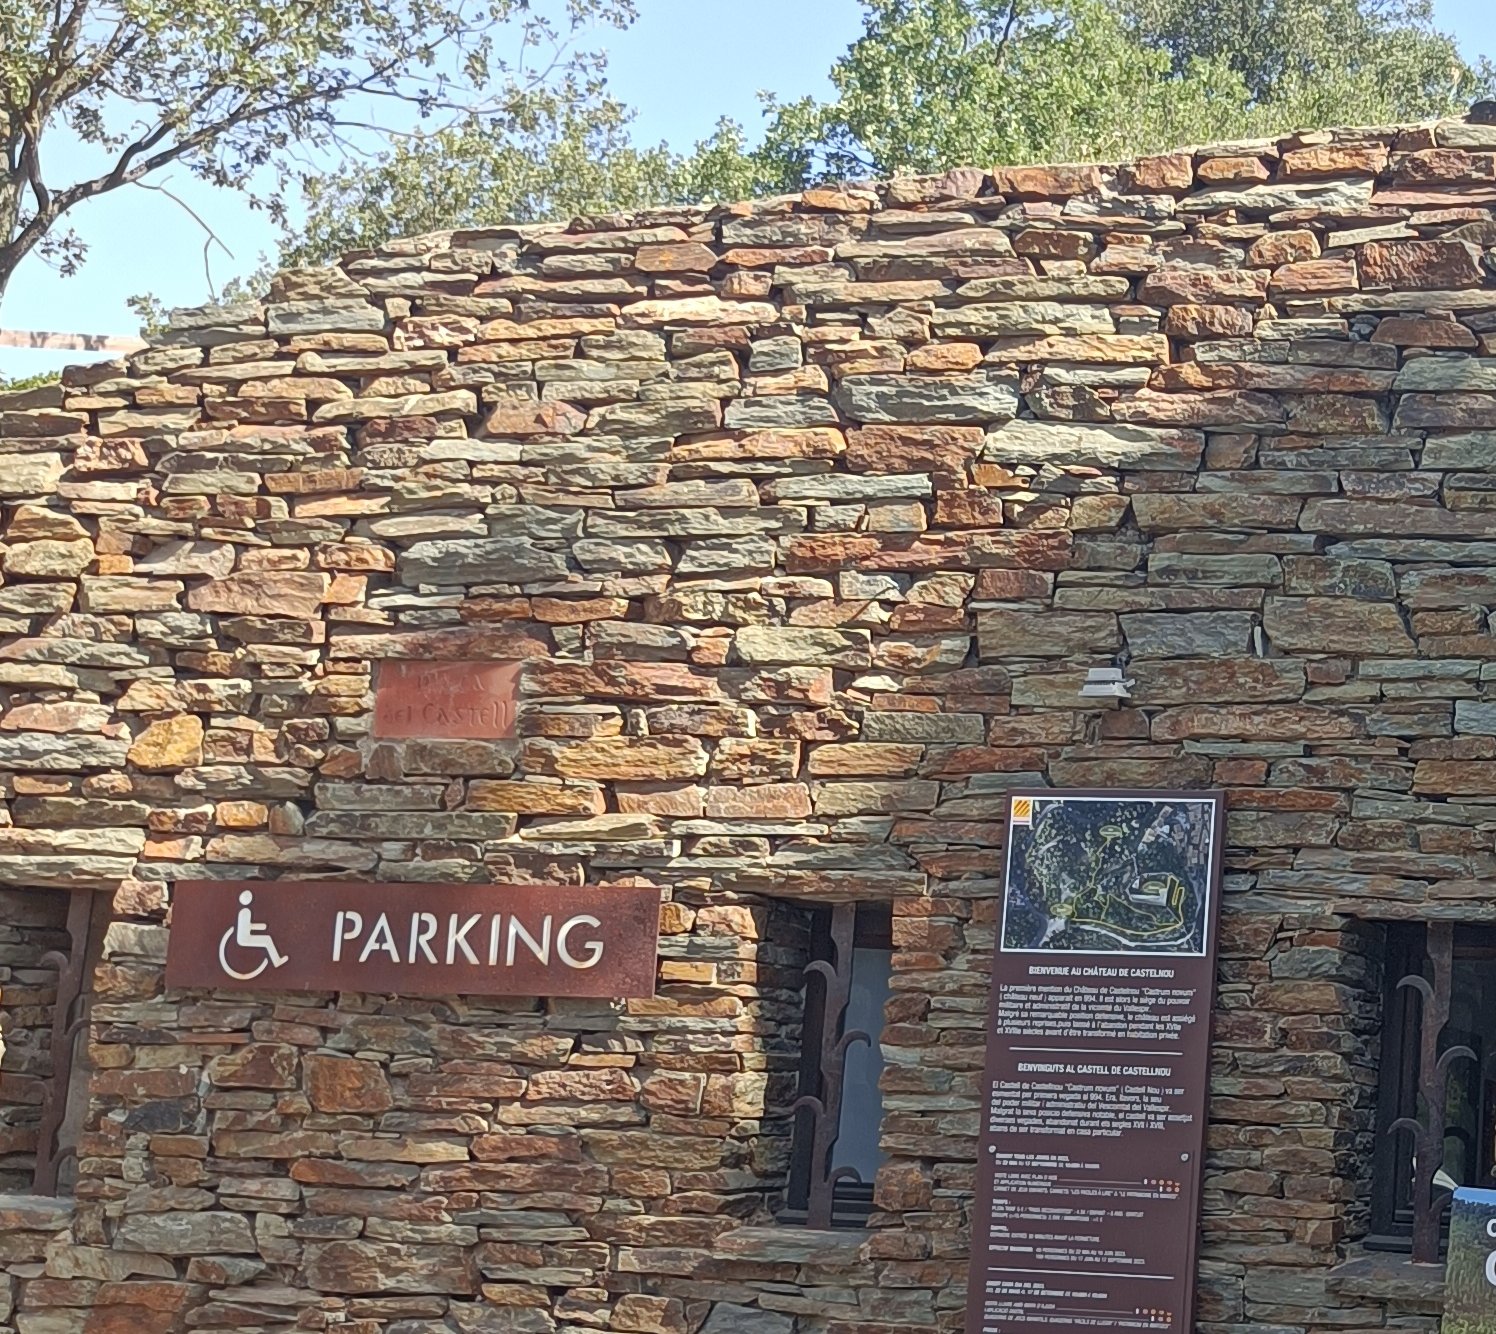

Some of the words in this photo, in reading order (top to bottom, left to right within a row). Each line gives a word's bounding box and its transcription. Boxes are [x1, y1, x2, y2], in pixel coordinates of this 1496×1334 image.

[332, 910, 605, 969] PARKING
[1071, 967, 1081, 975] AU
[1119, 968, 1129, 977] DE
[1111, 1065, 1121, 1075] DE
